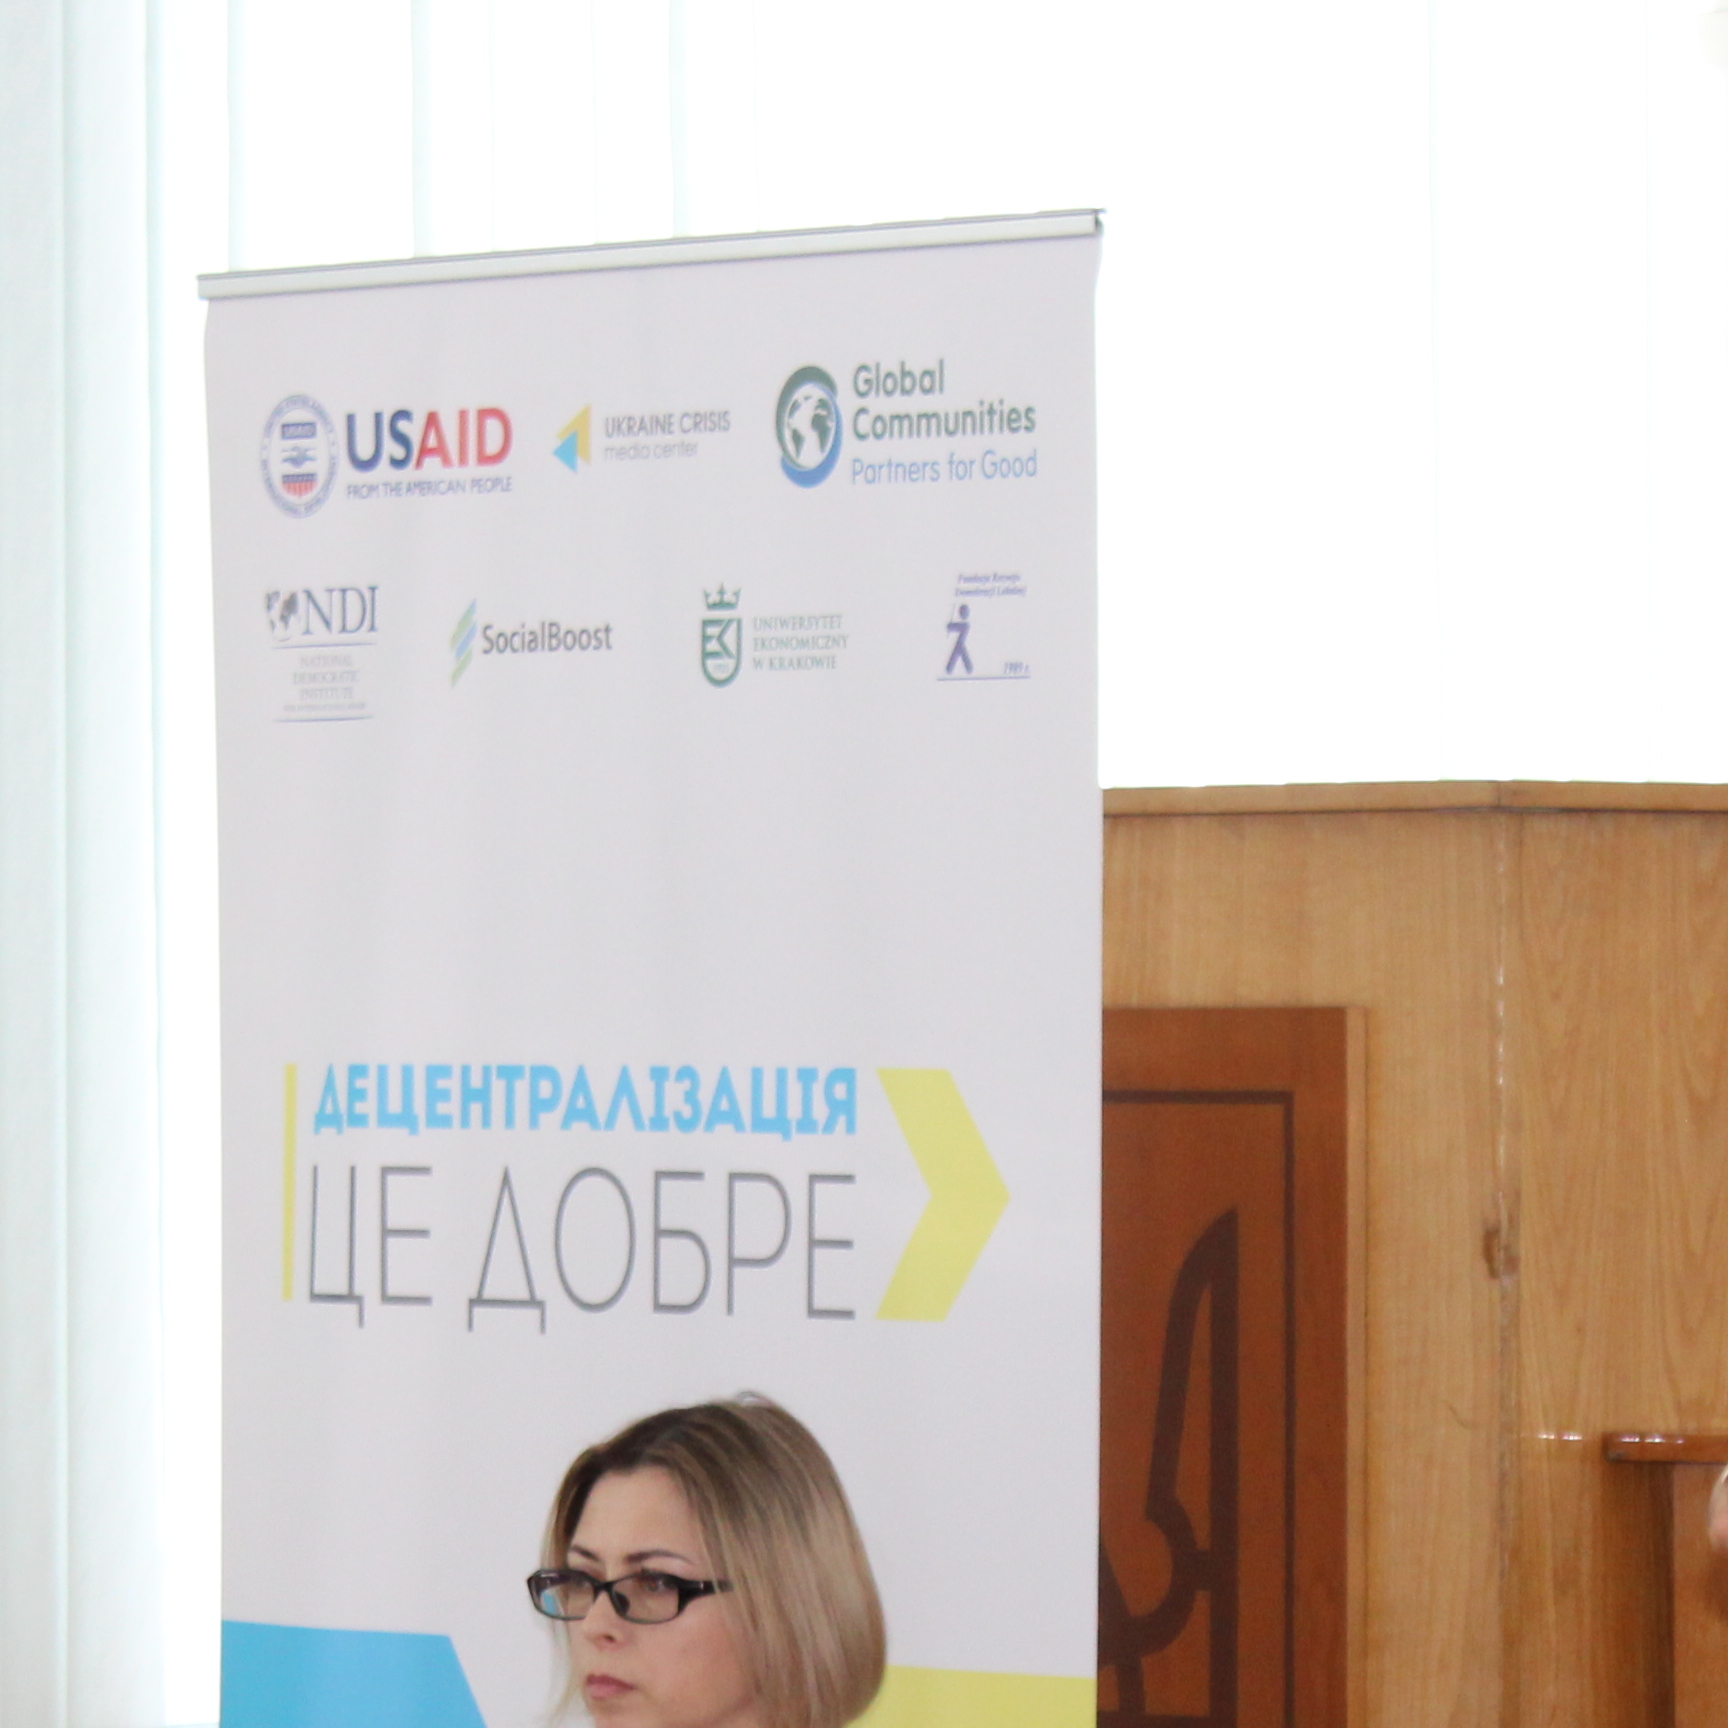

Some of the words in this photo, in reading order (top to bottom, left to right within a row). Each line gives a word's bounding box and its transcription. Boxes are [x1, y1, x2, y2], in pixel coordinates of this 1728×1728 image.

[852, 358, 945, 399] Global
[604, 413, 675, 438] UKRAINE
[679, 410, 731, 434] CRISIS
[852, 399, 1037, 441] Communities
[345, 407, 514, 473] USAID
[604, 442, 650, 460] media
[653, 439, 698, 459] center
[852, 456, 941, 485] Partners
[948, 451, 977, 481] for
[981, 448, 1038, 480] Good
[346, 483, 379, 499] FROM
[382, 481, 405, 497] THE
[406, 479, 466, 496] AMERICAN
[469, 476, 514, 494] PEOPLE
[301, 585, 379, 635] NDI
[752, 614, 845, 632] UNIWERSYTET
[480, 621, 614, 655] SocialBoost
[753, 635, 850, 652] EKONOMICZNY
[769, 655, 837, 670] KRAKOWIE
[314, 1062, 859, 1142] ДЕЦЕНТРАЛІЗАЦІЯ
[308, 1164, 434, 1330] ЦЕ
[467, 1164, 859, 1336] ДОБРЕ
